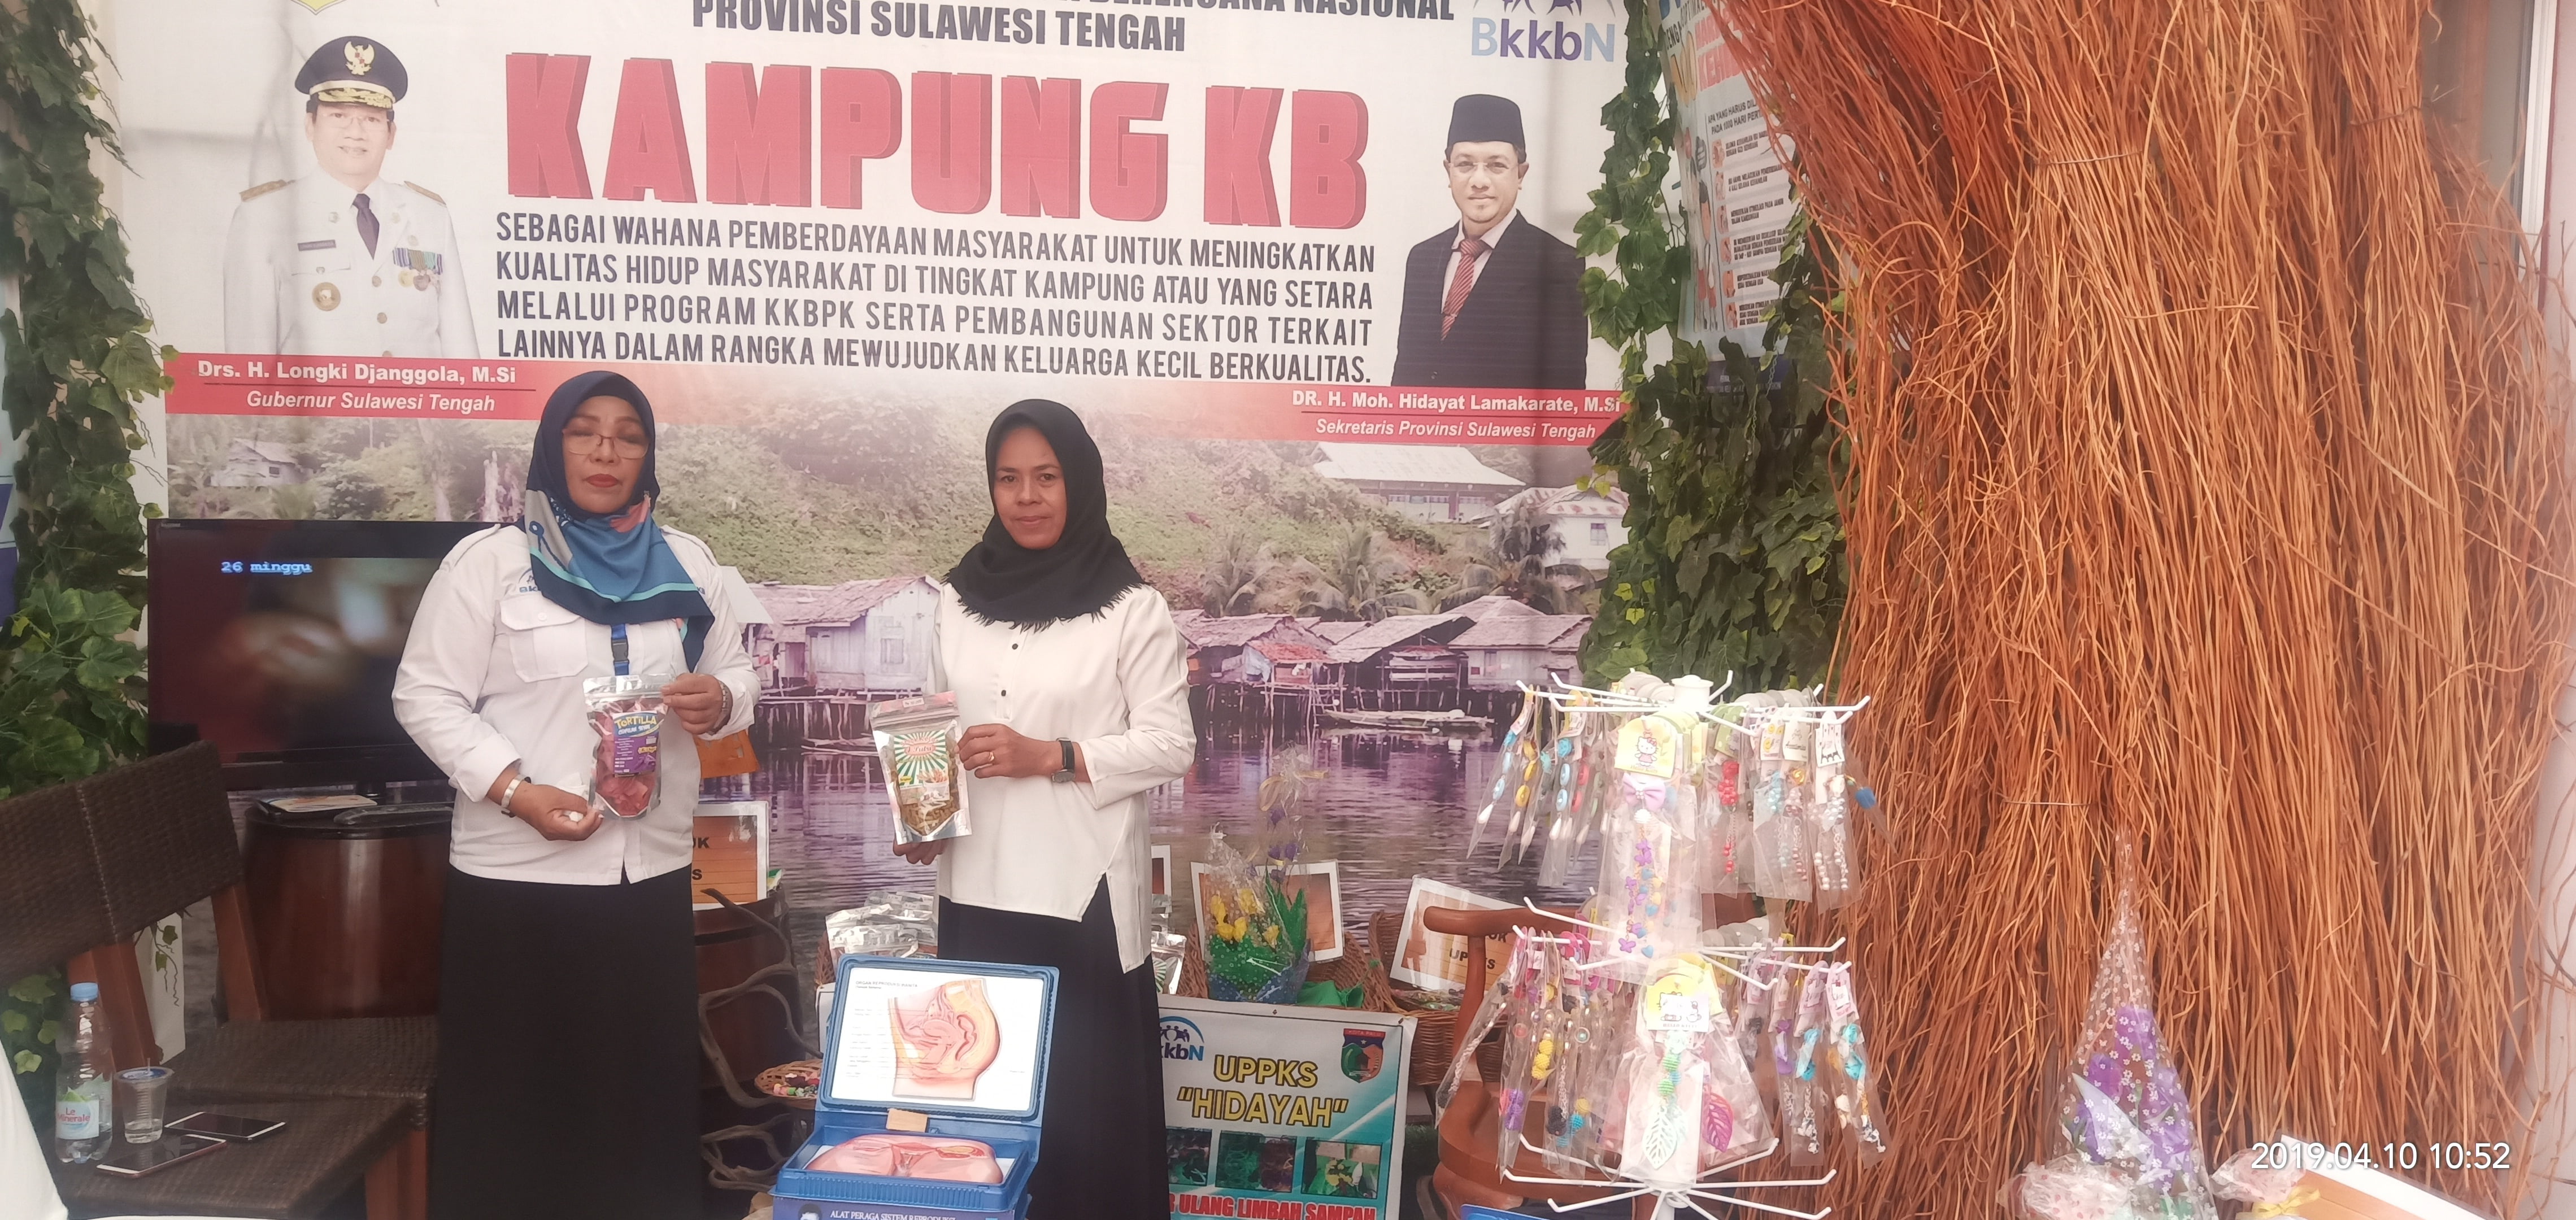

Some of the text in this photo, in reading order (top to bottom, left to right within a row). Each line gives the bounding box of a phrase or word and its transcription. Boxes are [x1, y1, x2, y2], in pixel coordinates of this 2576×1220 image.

[693, 0, 1185, 51] PROVINSI SULAWESI TENGAH
[1472, 18, 1615, 62] BkkbN
[506, 52, 1369, 230] KAMPUNG KB
[497, 212, 1374, 272] SEBAGAI WAHANA PEMBERDAYAAN MASYARAKAT UNTUK MENINGKATKAN
[497, 251, 1373, 310] KUALITAS HIDUP MASYARAKAT DI TINGKAT KAMPUNG ATAU YANG SETARA
[498, 291, 1372, 346] MELALUI PROGRAM KKBPK SERTA PEMBANGUNAN SEKTOR TERKAIT
[198, 360, 516, 386] Drs. H. Longki Djanggola, M.Si
[498, 329, 1371, 383] LAINNYA DALAM RANGKA MEWUJUDKAN KELUARGA KECIL BERKUALITAS.
[246, 390, 495, 415] Gubernur Sulawesi Tengah
[1293, 391, 1621, 415] DR. H. Moh. Hidayat Lamakarate, M.Si
[1316, 418, 1596, 441] Sekretaris Provinsi Sulawesi Tengah
[221, 561, 312, 575] 26 minggu
[614, 715, 657, 729] TORTILLA
[1213, 1054, 1318, 1088] UPPKS
[1177, 1087, 1349, 1127] "HIDAYAH"
[851, 1212, 880, 1220] PERAGA
[1180, 1194, 1234, 1216] ULANG
[1237, 1199, 1302, 1220] LIMBAH
[1306, 1204, 1376, 1220] SAMPAH
